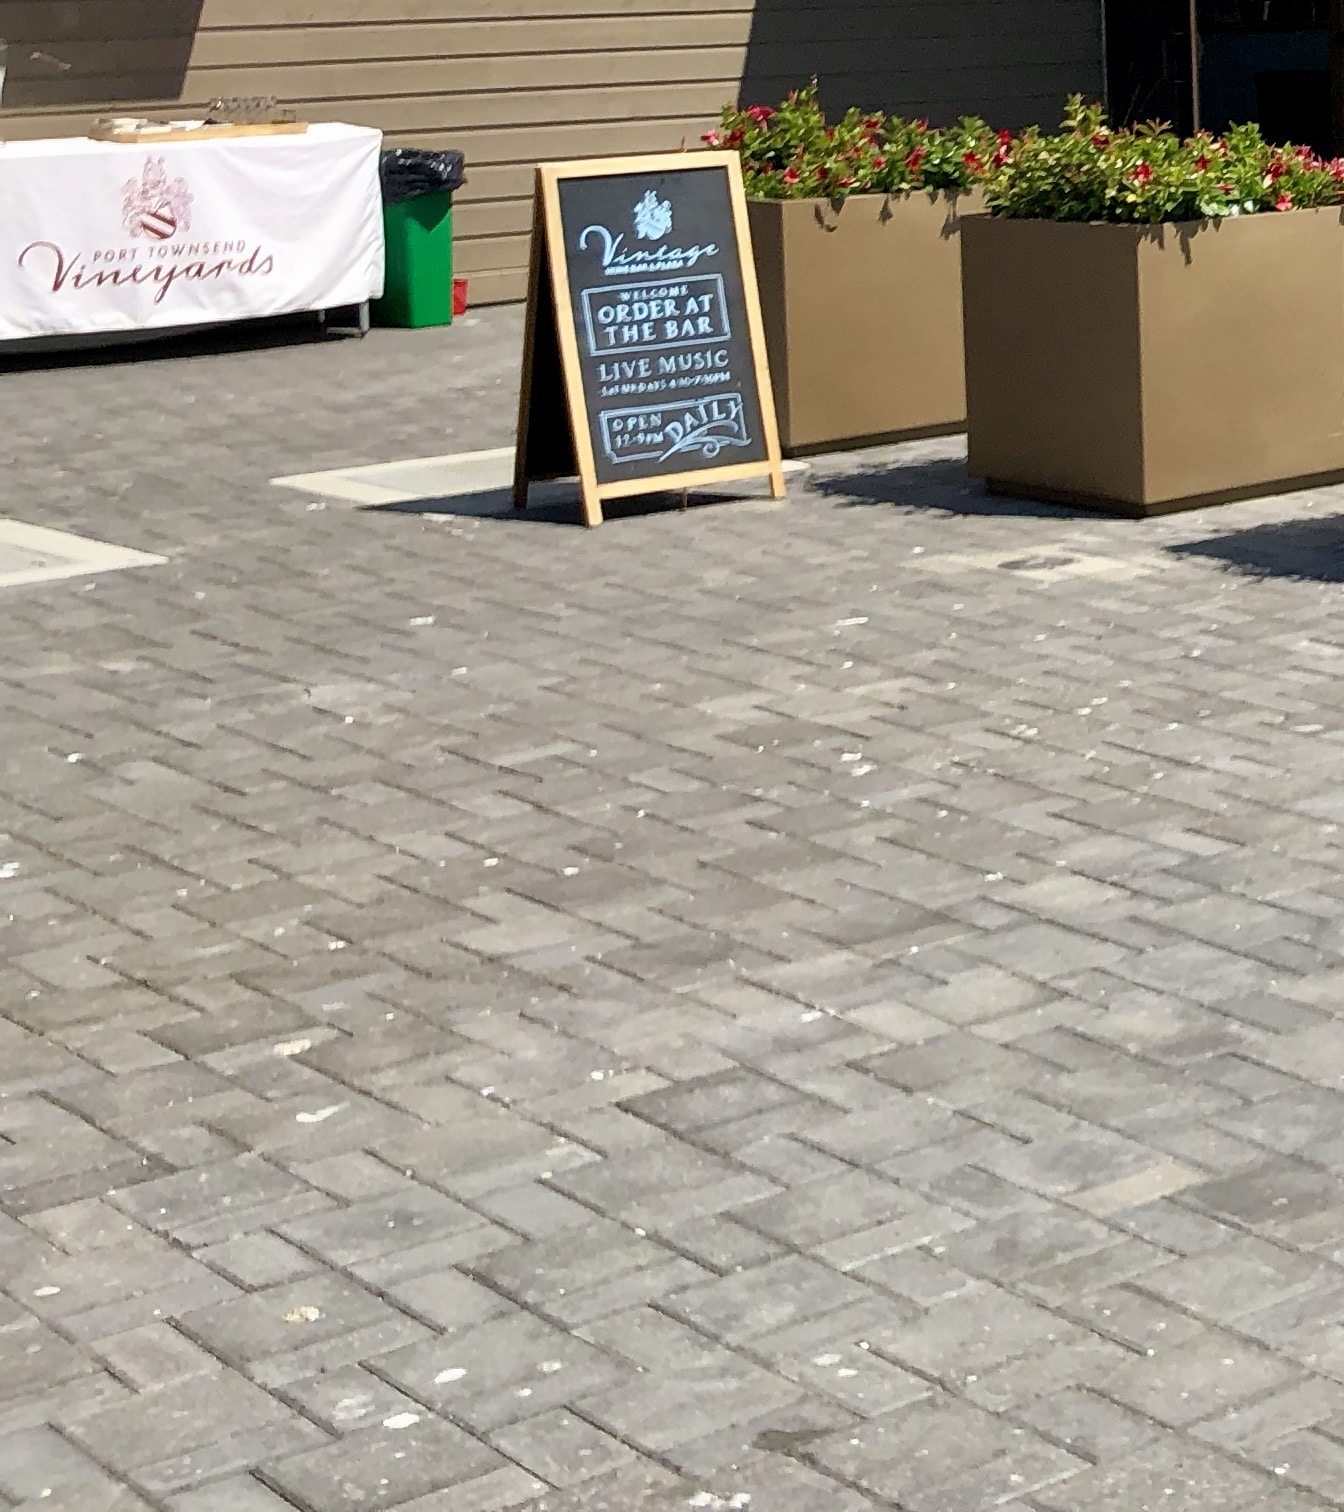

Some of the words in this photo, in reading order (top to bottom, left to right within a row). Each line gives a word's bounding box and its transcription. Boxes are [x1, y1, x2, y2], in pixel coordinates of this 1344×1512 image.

[92, 246, 137, 264] PORT
[147, 239, 247, 260] TOWNSEND
[579, 224, 720, 268] Vintage
[17, 240, 274, 304] Vineyards
[618, 284, 689, 302] WELCOME
[597, 299, 680, 324] ORDER
[684, 294, 713, 316] AT
[603, 322, 657, 346] THE
[664, 316, 714, 340] BAR
[597, 358, 653, 383] LIVE
[657, 349, 730, 375] MUSIC
[612, 413, 662, 432] OPEN
[664, 400, 743, 443] DAILY
